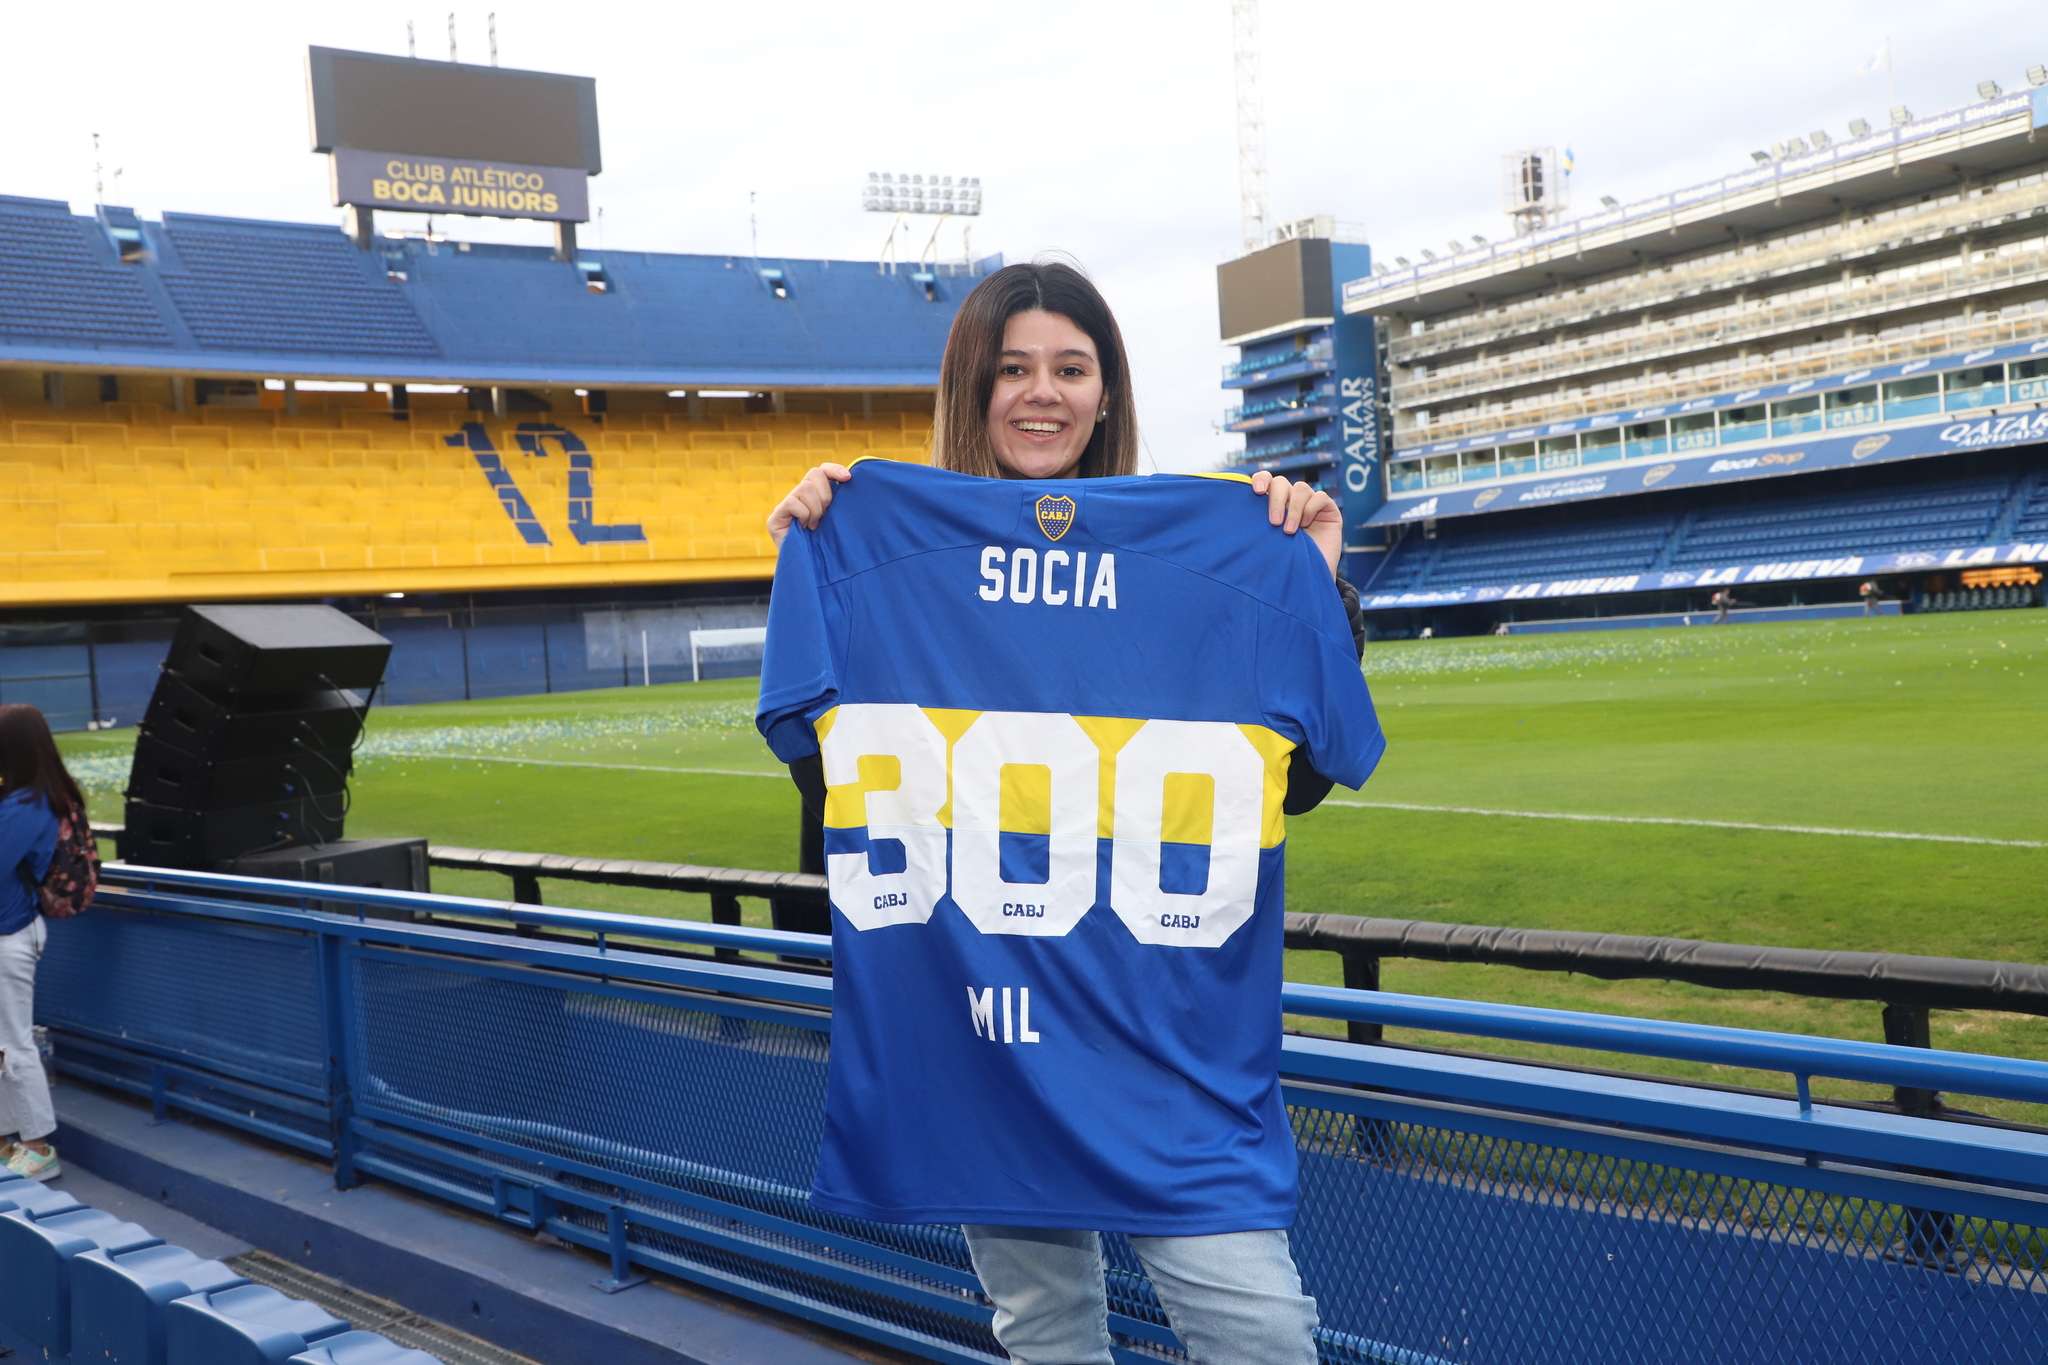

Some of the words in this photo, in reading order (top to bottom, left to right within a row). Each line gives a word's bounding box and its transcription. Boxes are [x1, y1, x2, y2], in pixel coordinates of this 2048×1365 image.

[386, 160, 445, 183] CLUB
[451, 166, 544, 191] ATLÉTICO
[372, 179, 446, 205] BOCA
[451, 186, 559, 213] JUNIORS
[1341, 377, 1371, 492] QATAR
[1361, 377, 1377, 462] AIRWAYS
[443, 422, 647, 545] 12
[1041, 511, 1069, 521] CABJ
[1695, 566, 1743, 586] LA
[1744, 556, 1864, 582] NUEVA
[1943, 547, 1997, 566] LA
[978, 545, 1117, 609] SOCIA
[1503, 582, 1542, 599] LA
[1542, 575, 1640, 596] NUEVA
[822, 703, 1265, 948] 300
[874, 892, 907, 910] CABJ
[1002, 902, 1045, 919] CABJ
[1160, 913, 1201, 930] CABJ
[966, 986, 1040, 1044] MIL
